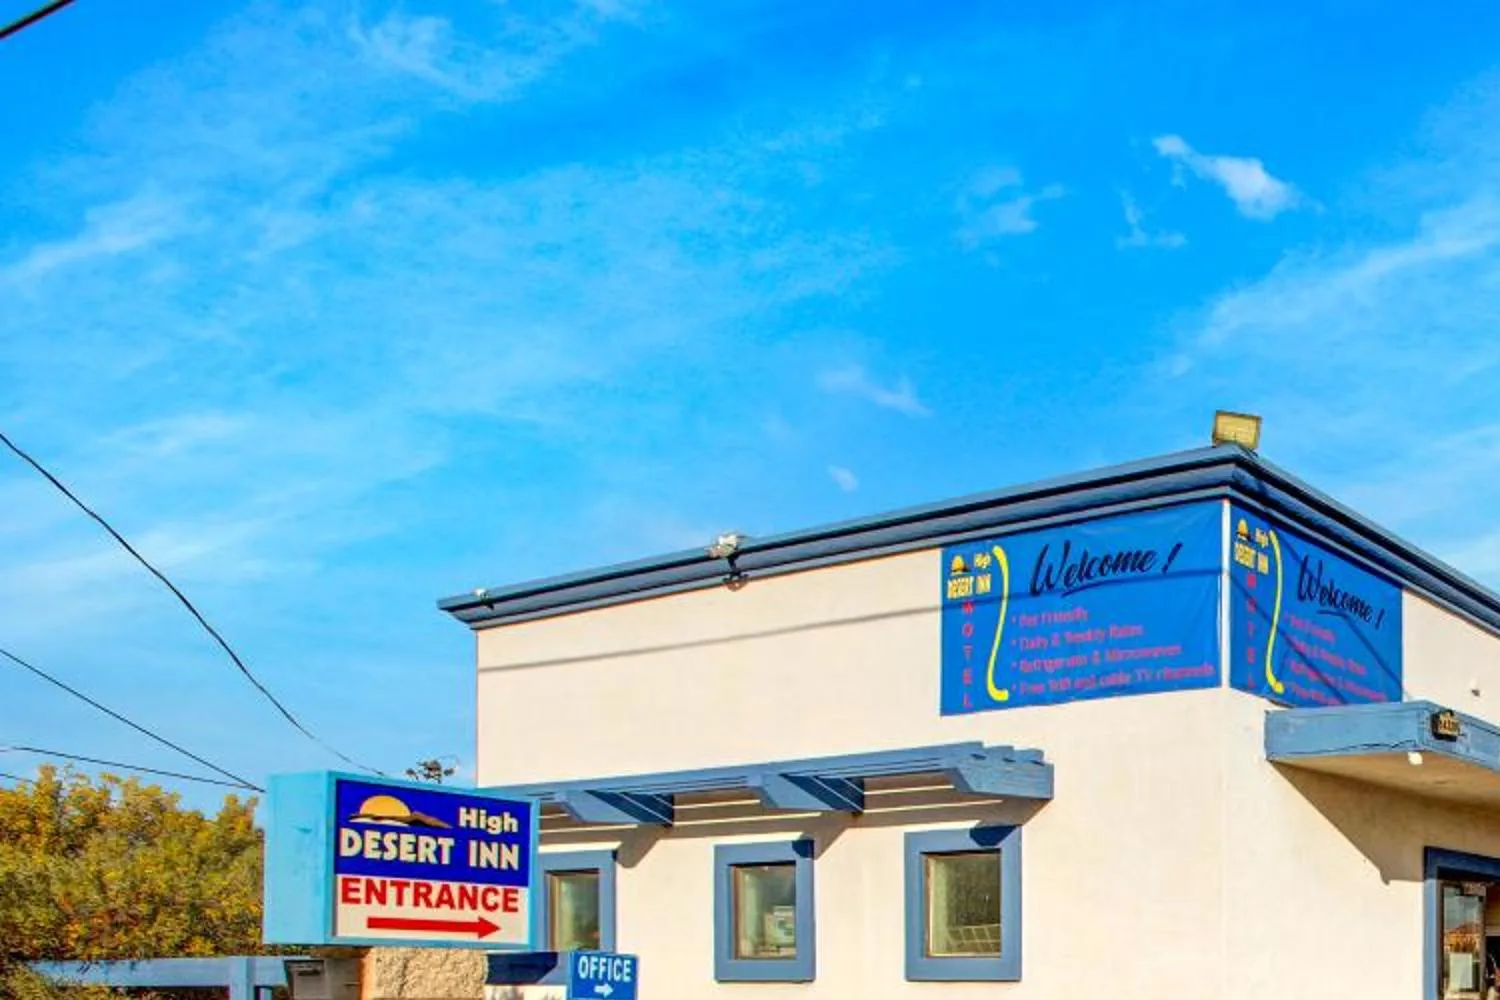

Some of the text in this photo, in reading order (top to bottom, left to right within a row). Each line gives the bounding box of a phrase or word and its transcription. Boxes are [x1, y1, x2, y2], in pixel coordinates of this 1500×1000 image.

[458, 806, 519, 835] High
[339, 827, 520, 871] DESERT INN
[340, 877, 520, 913] ENTRANCE
[577, 954, 632, 982] OFFICE
